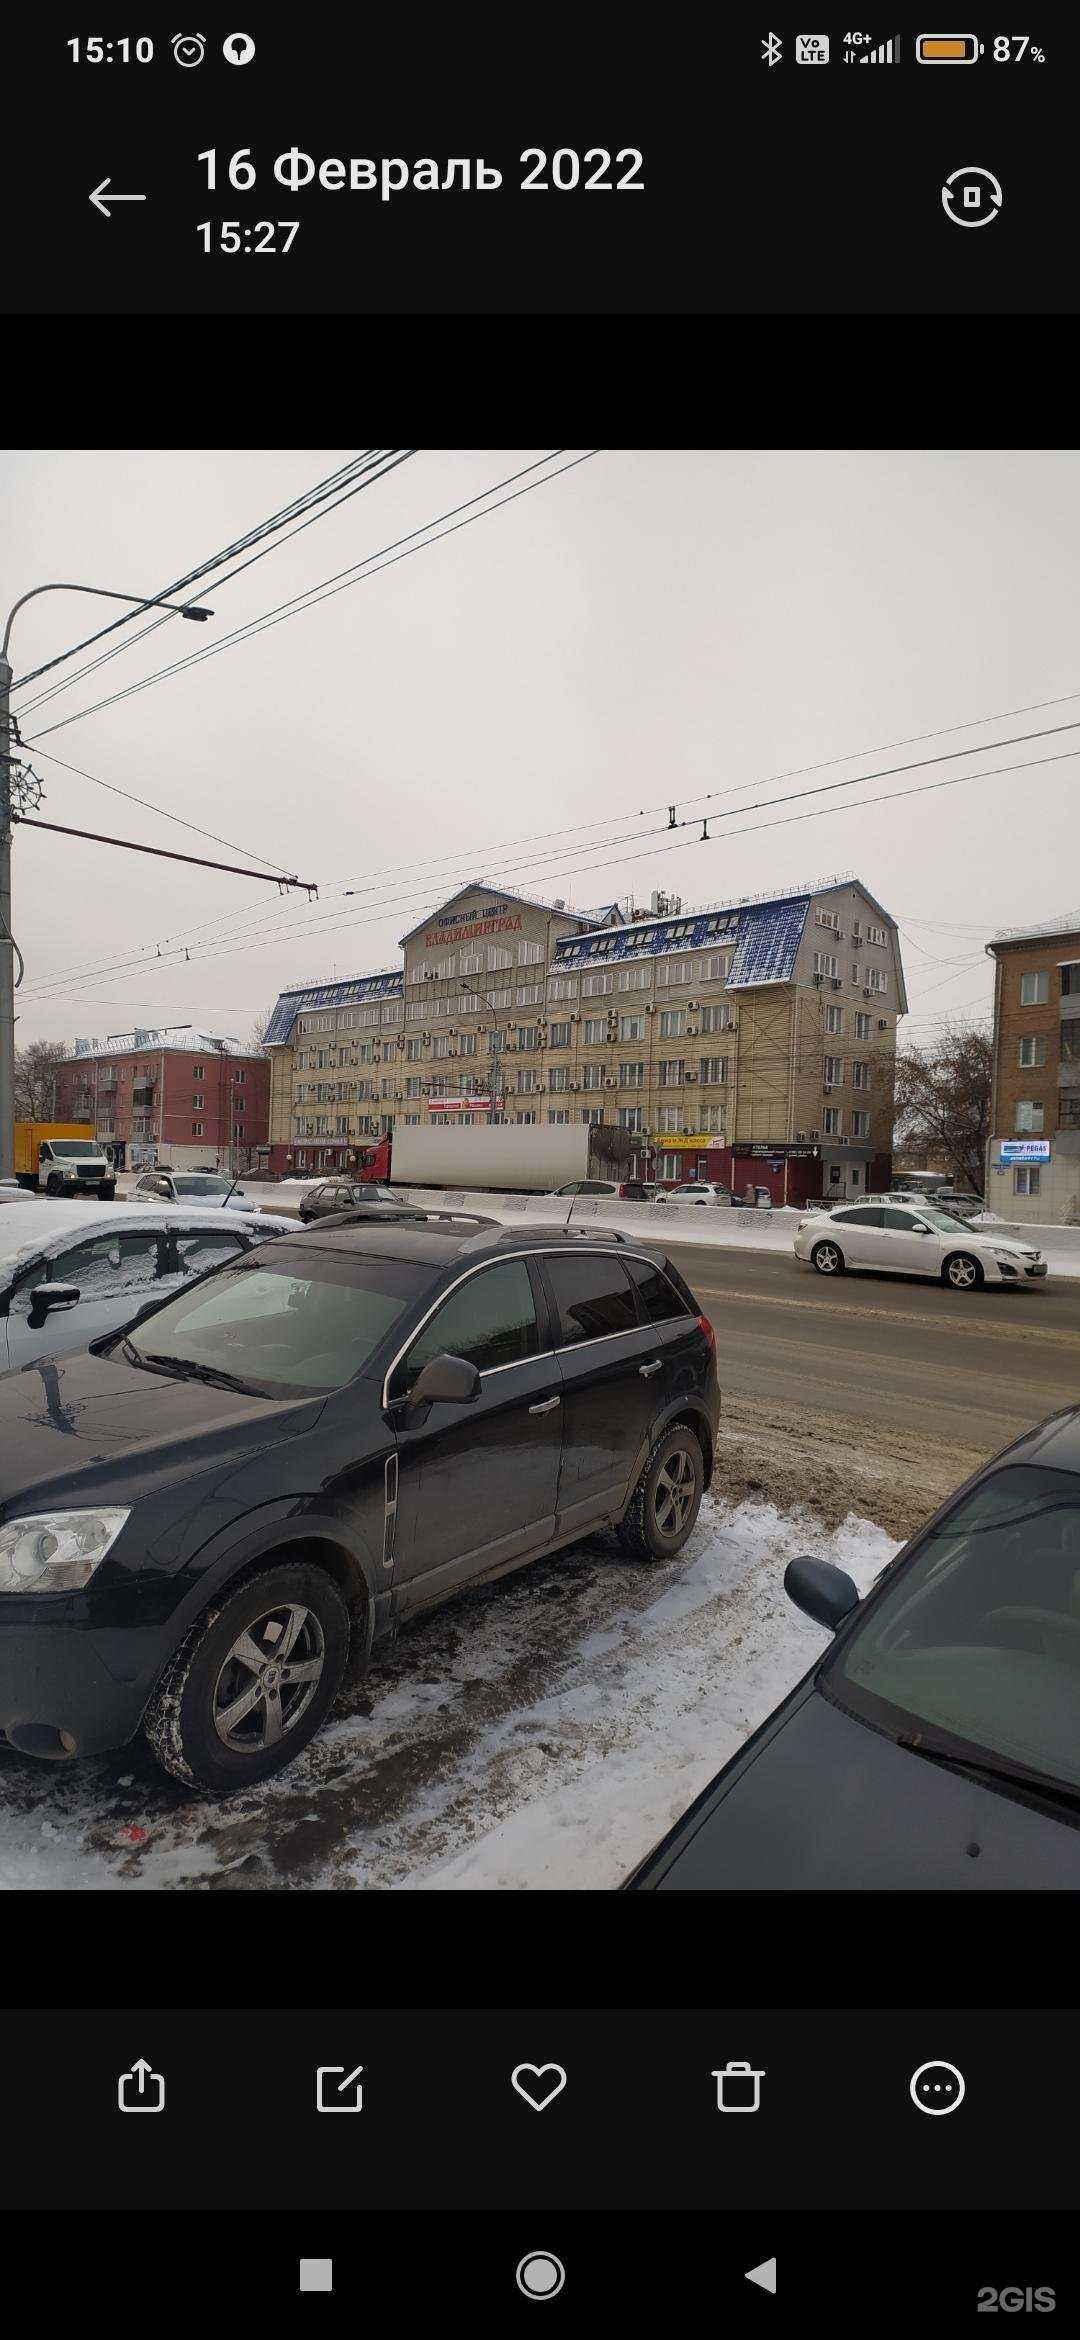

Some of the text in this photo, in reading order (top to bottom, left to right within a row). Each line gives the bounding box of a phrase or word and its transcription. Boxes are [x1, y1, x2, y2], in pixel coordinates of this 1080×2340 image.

[800, 38, 820, 48] Vo
[843, 32, 872, 45] 4G+
[66, 37, 154, 64] 15:10
[801, 50, 825, 61] LTE
[197, 146, 645, 202] 16 Февраль 2022
[196, 220, 300, 254] 15:27
